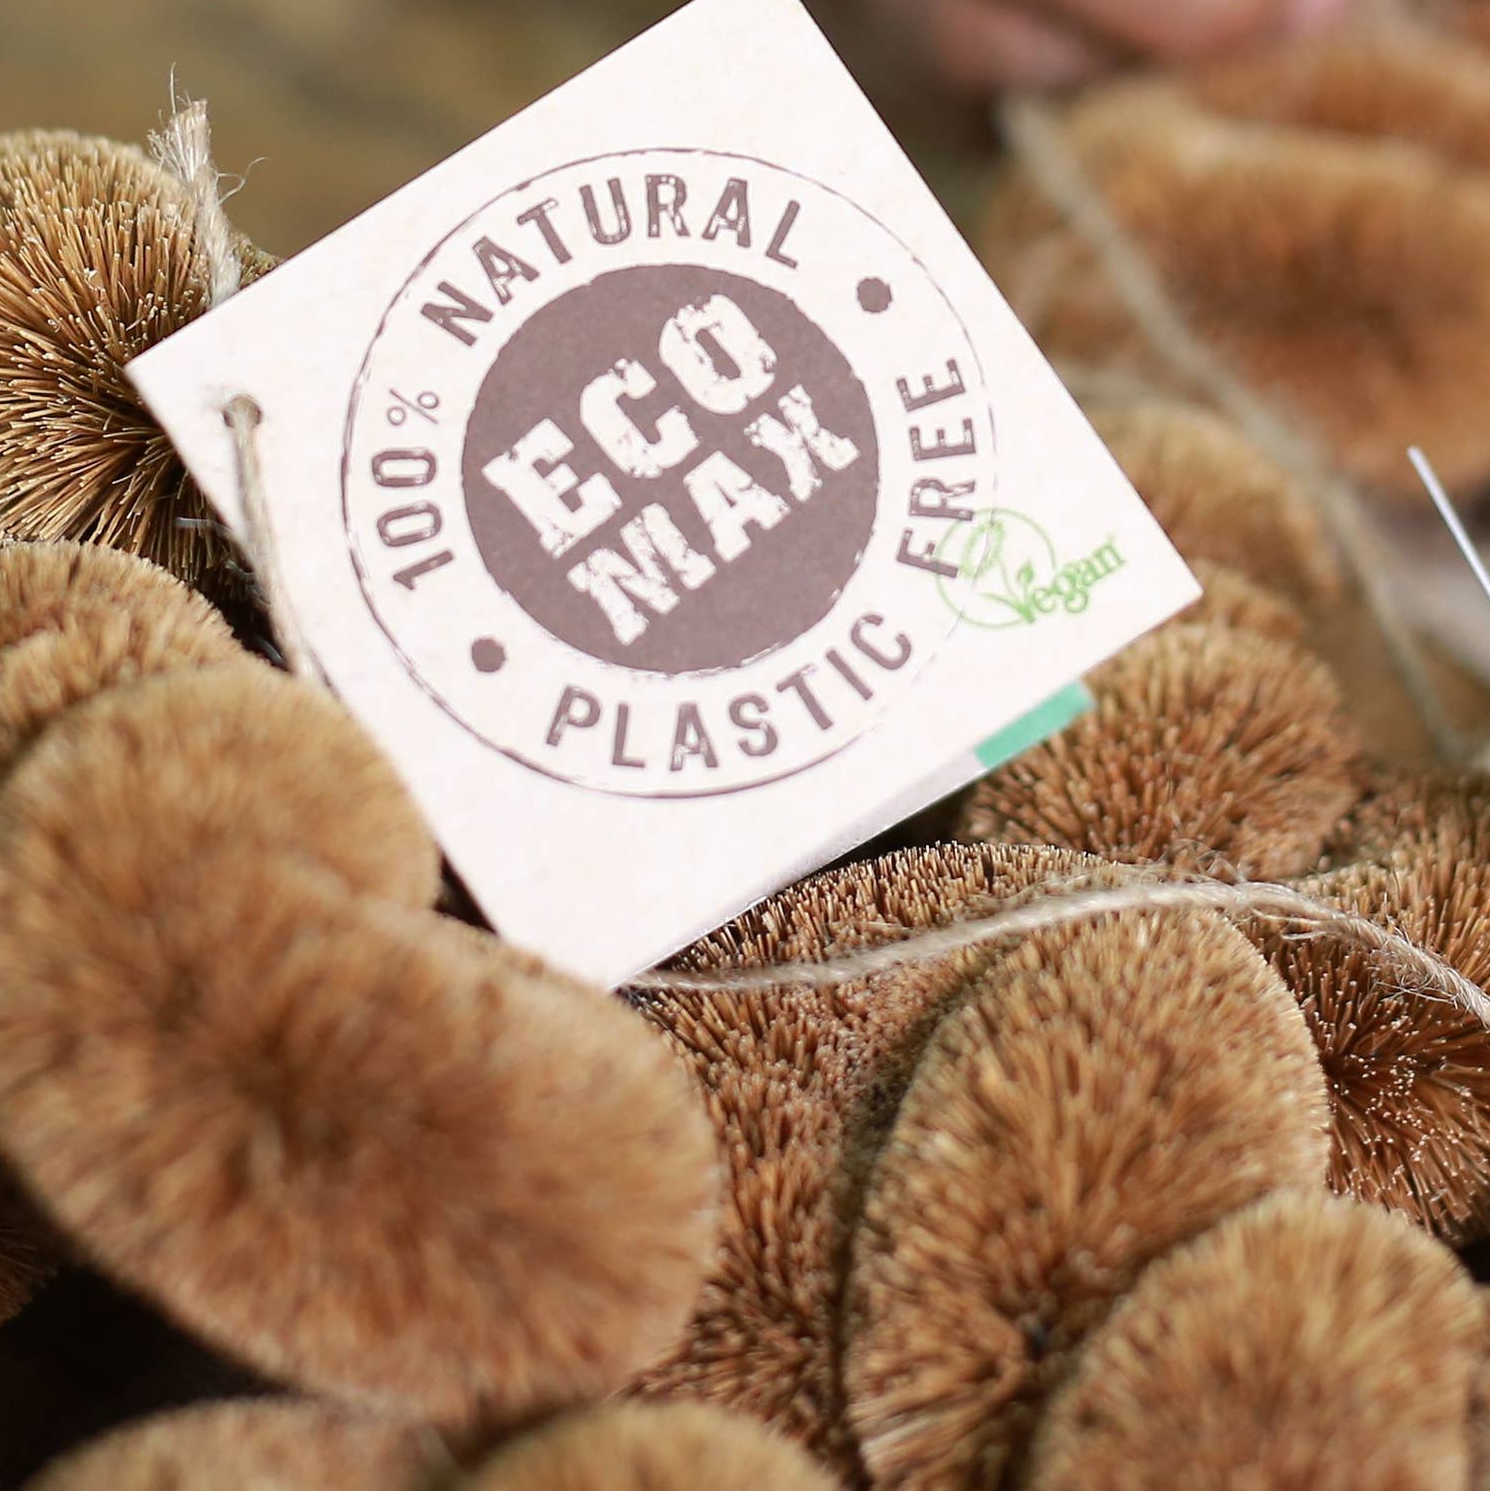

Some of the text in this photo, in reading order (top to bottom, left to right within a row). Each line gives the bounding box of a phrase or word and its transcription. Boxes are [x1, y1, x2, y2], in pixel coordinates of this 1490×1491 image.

[374, 173, 805, 592] 100% NATURAL
[483, 293, 778, 561] ECO
[567, 383, 860, 644] MAX
[544, 356, 973, 771] PLASTIC FREE
[981, 542, 1126, 623] Vegan
